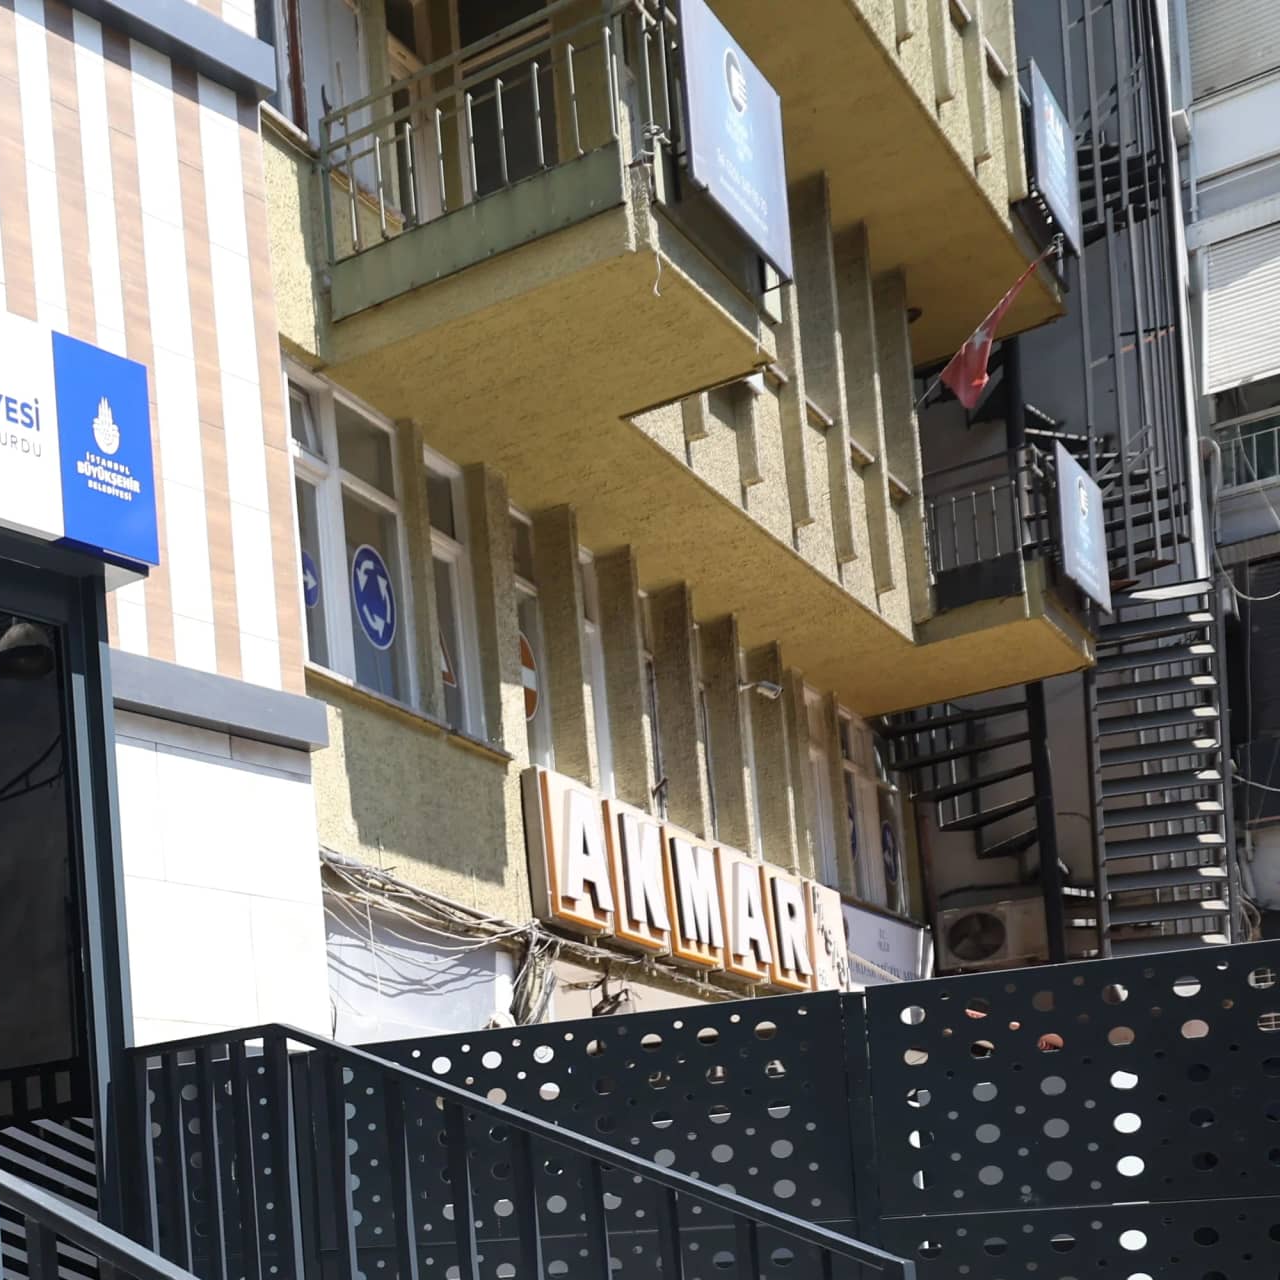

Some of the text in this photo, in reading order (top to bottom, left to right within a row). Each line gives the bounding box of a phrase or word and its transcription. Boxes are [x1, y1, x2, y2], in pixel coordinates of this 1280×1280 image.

[76, 460, 141, 493] BÜYÜKŞEHİR
[86, 451, 130, 475] İSTANBUL
[561, 787, 813, 977] AKMAR
